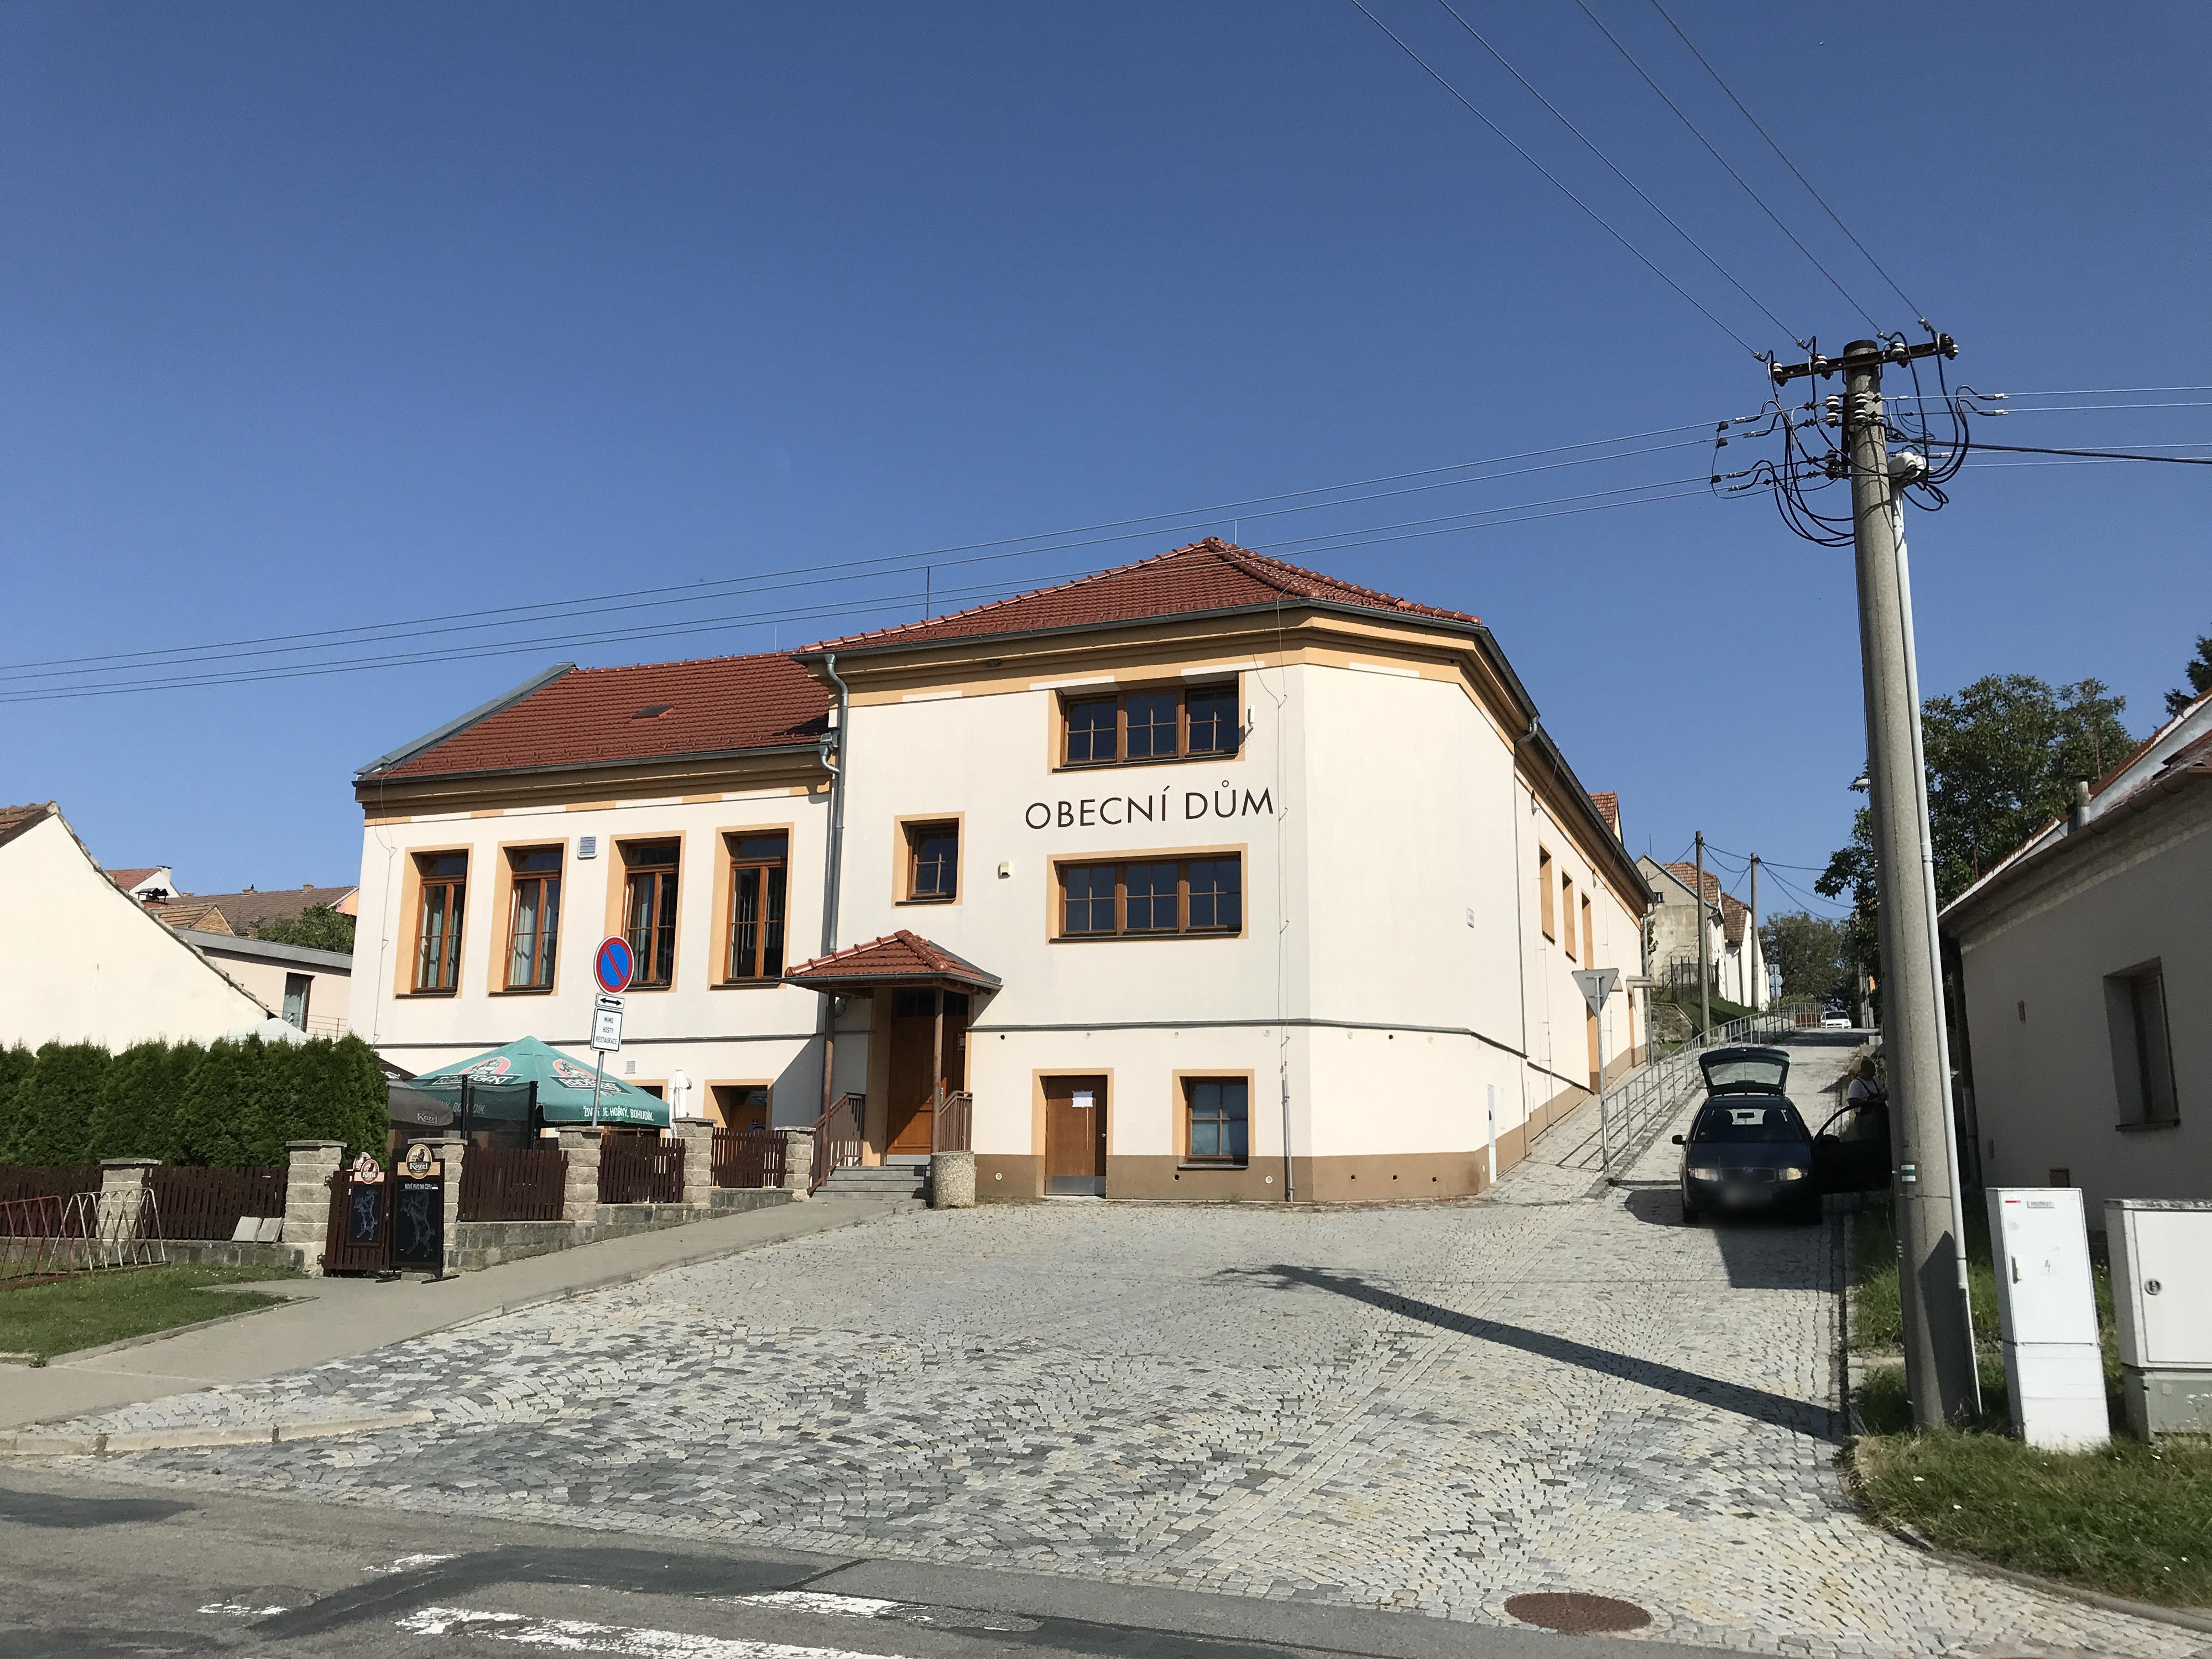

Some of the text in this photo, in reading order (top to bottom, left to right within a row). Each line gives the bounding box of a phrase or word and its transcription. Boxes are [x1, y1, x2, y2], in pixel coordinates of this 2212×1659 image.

[1025, 780, 1274, 830] OBECNÍ DŮM
[596, 1036, 618, 1045] RESTAURACE
[417, 1113, 438, 1124] Kozel
[583, 1106, 601, 1117] ŽIVT
[602, 1107, 609, 1117] JE
[630, 1109, 654, 1121] BOHUDÍK.
